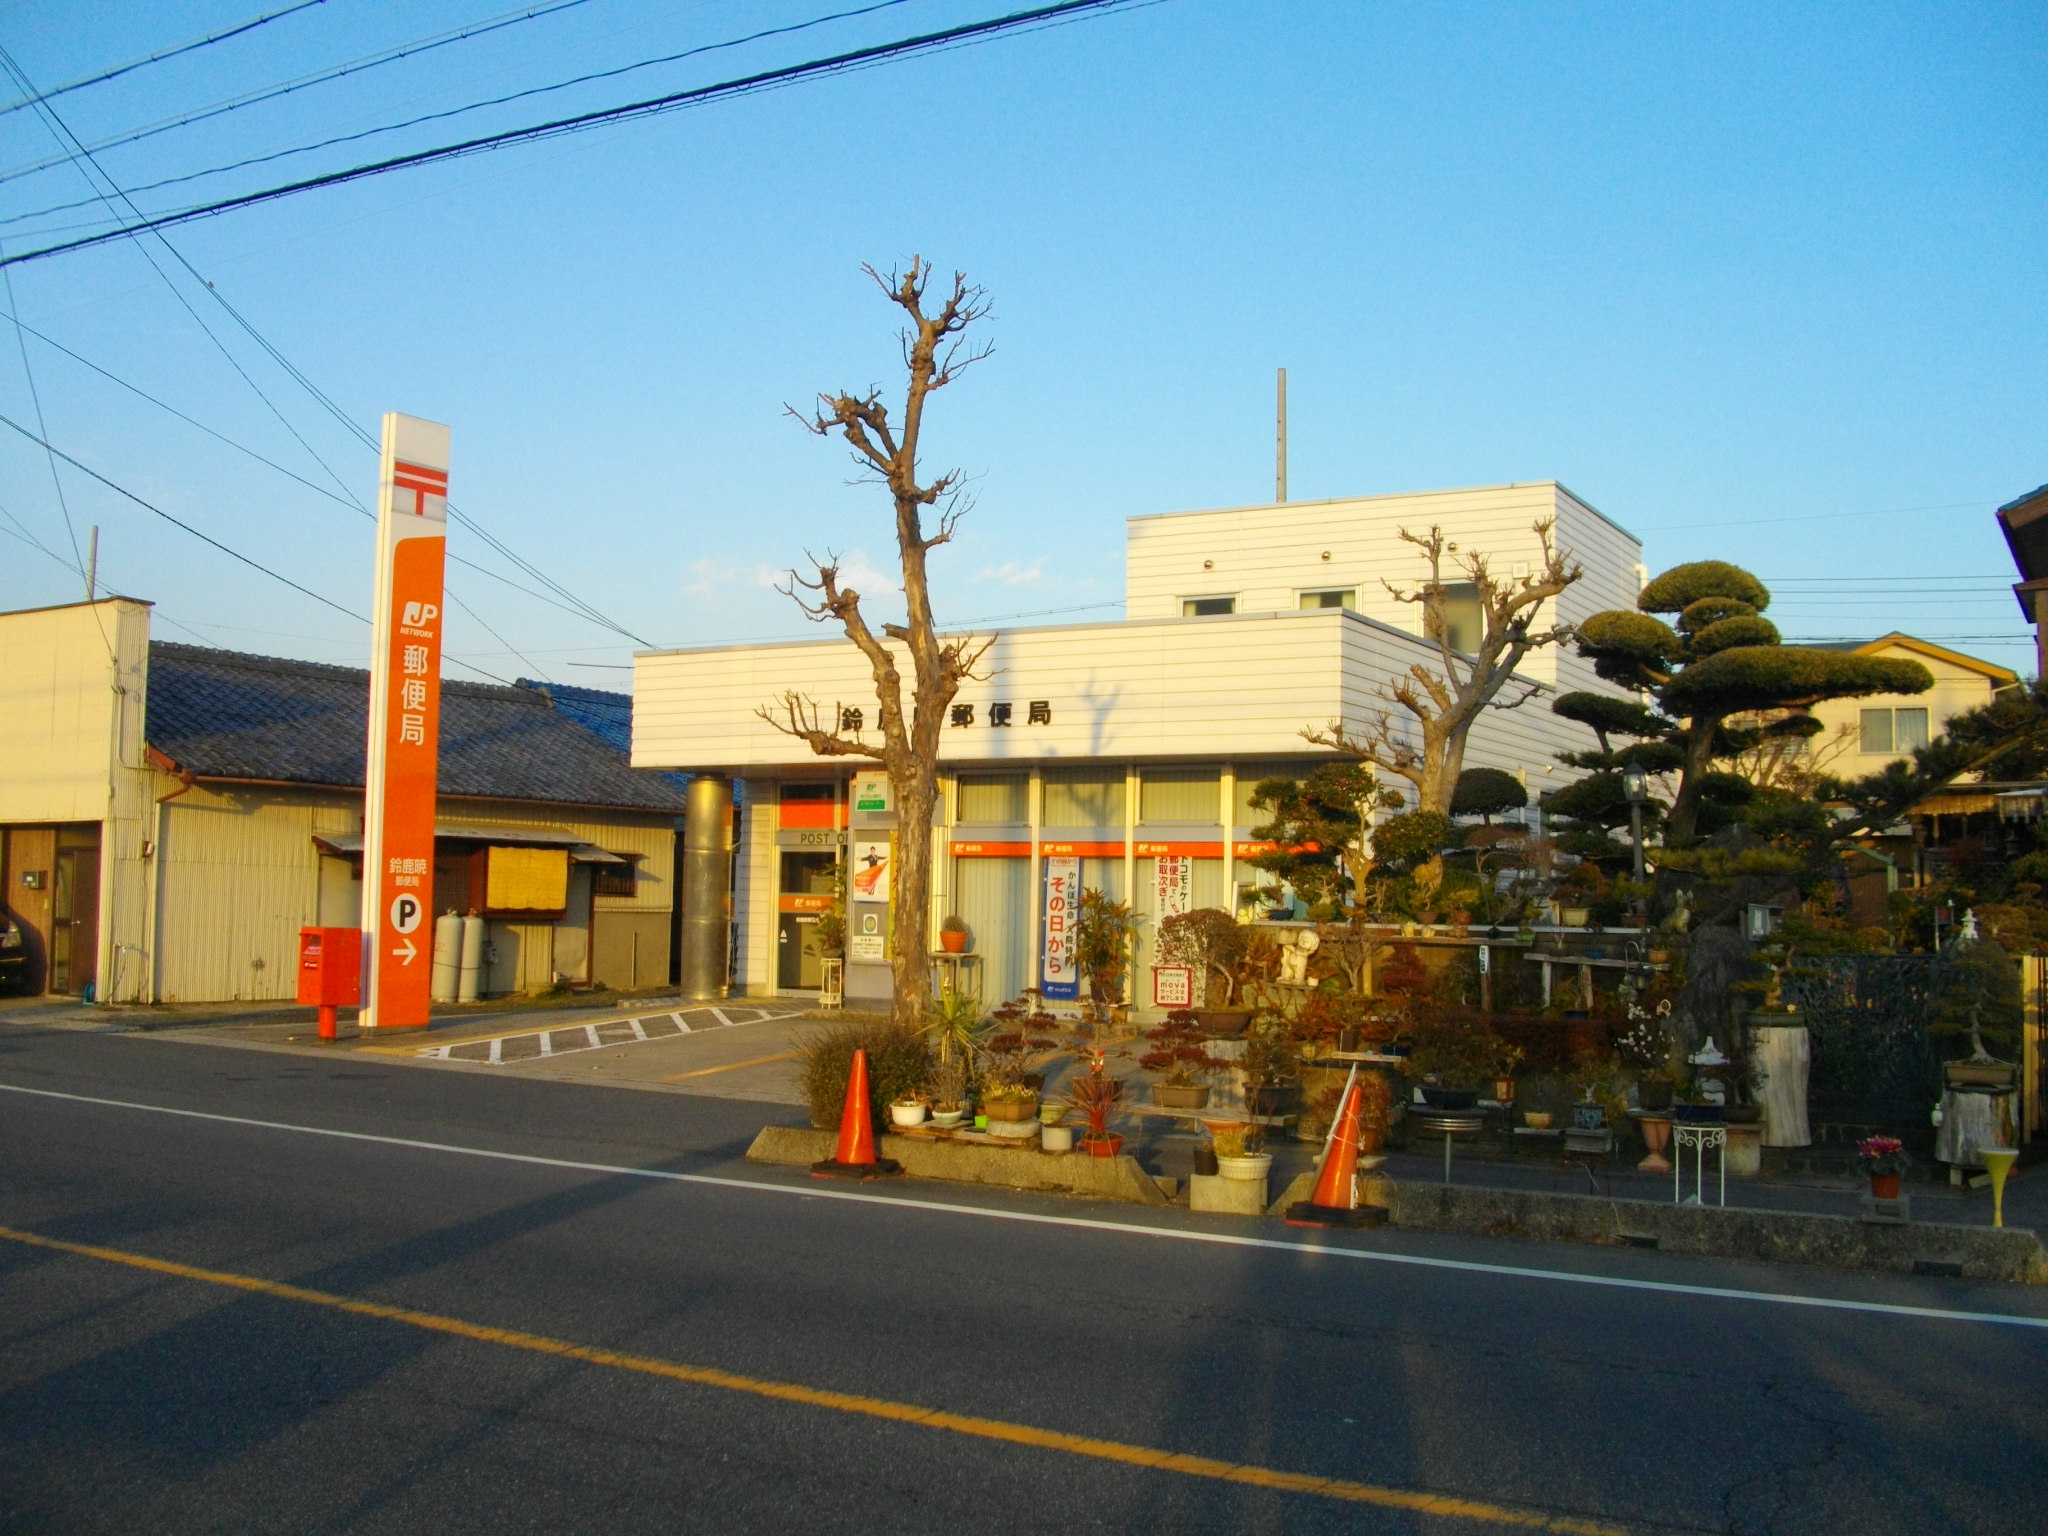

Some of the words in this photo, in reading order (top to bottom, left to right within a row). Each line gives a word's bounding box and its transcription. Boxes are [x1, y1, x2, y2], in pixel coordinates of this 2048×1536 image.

[402, 601, 438, 627] JP
[400, 626, 434, 639] NETWORK
[399, 644, 429, 746] 郵便局
[842, 701, 1052, 732] 鈴郵便局
[800, 833, 830, 844] POST
[395, 875, 419, 887] 郵便局
[399, 899, 417, 928] P
[1048, 877, 1066, 974] その日から
